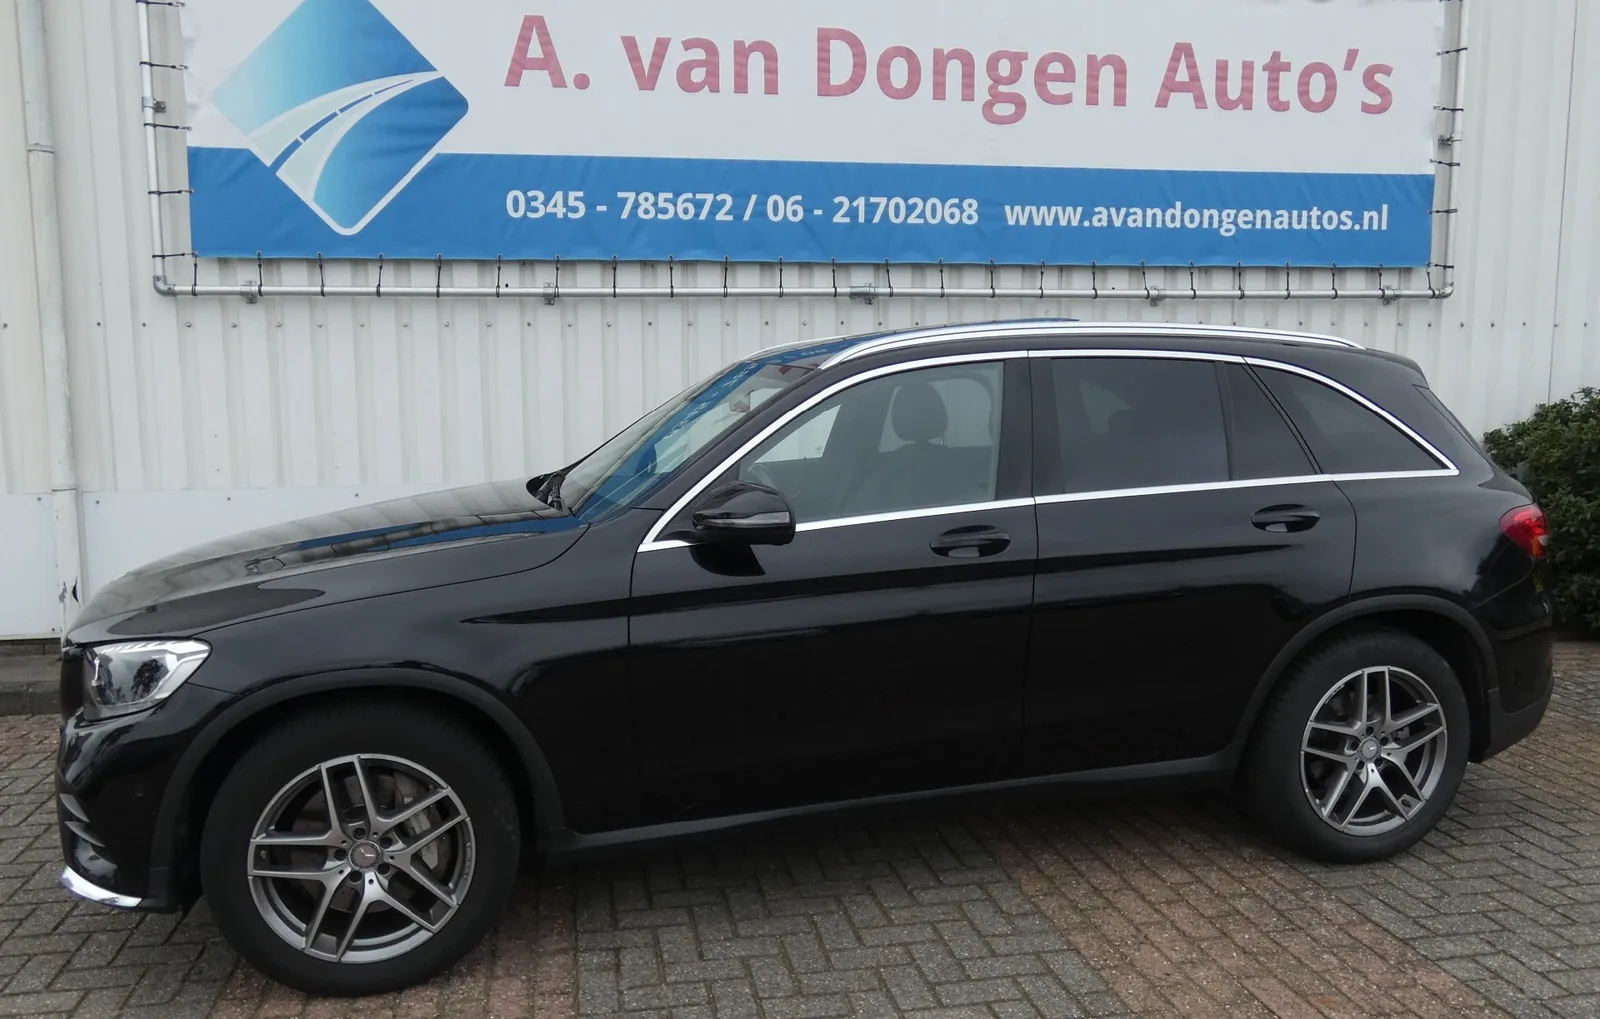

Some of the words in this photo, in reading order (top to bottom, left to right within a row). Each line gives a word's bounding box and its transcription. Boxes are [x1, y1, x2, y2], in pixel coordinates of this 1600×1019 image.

[504, 14, 591, 89] A.
[621, 35, 779, 95] van
[816, 27, 1128, 125] Dongen
[505, 189, 586, 219] 0345
[596, 204, 607, 212] -
[617, 191, 734, 221] 785672
[743, 194, 758, 221] /
[766, 194, 804, 222] 06
[832, 195, 979, 225] 21702068
[1004, 201, 1389, 237] www.avandongenautos.nl
